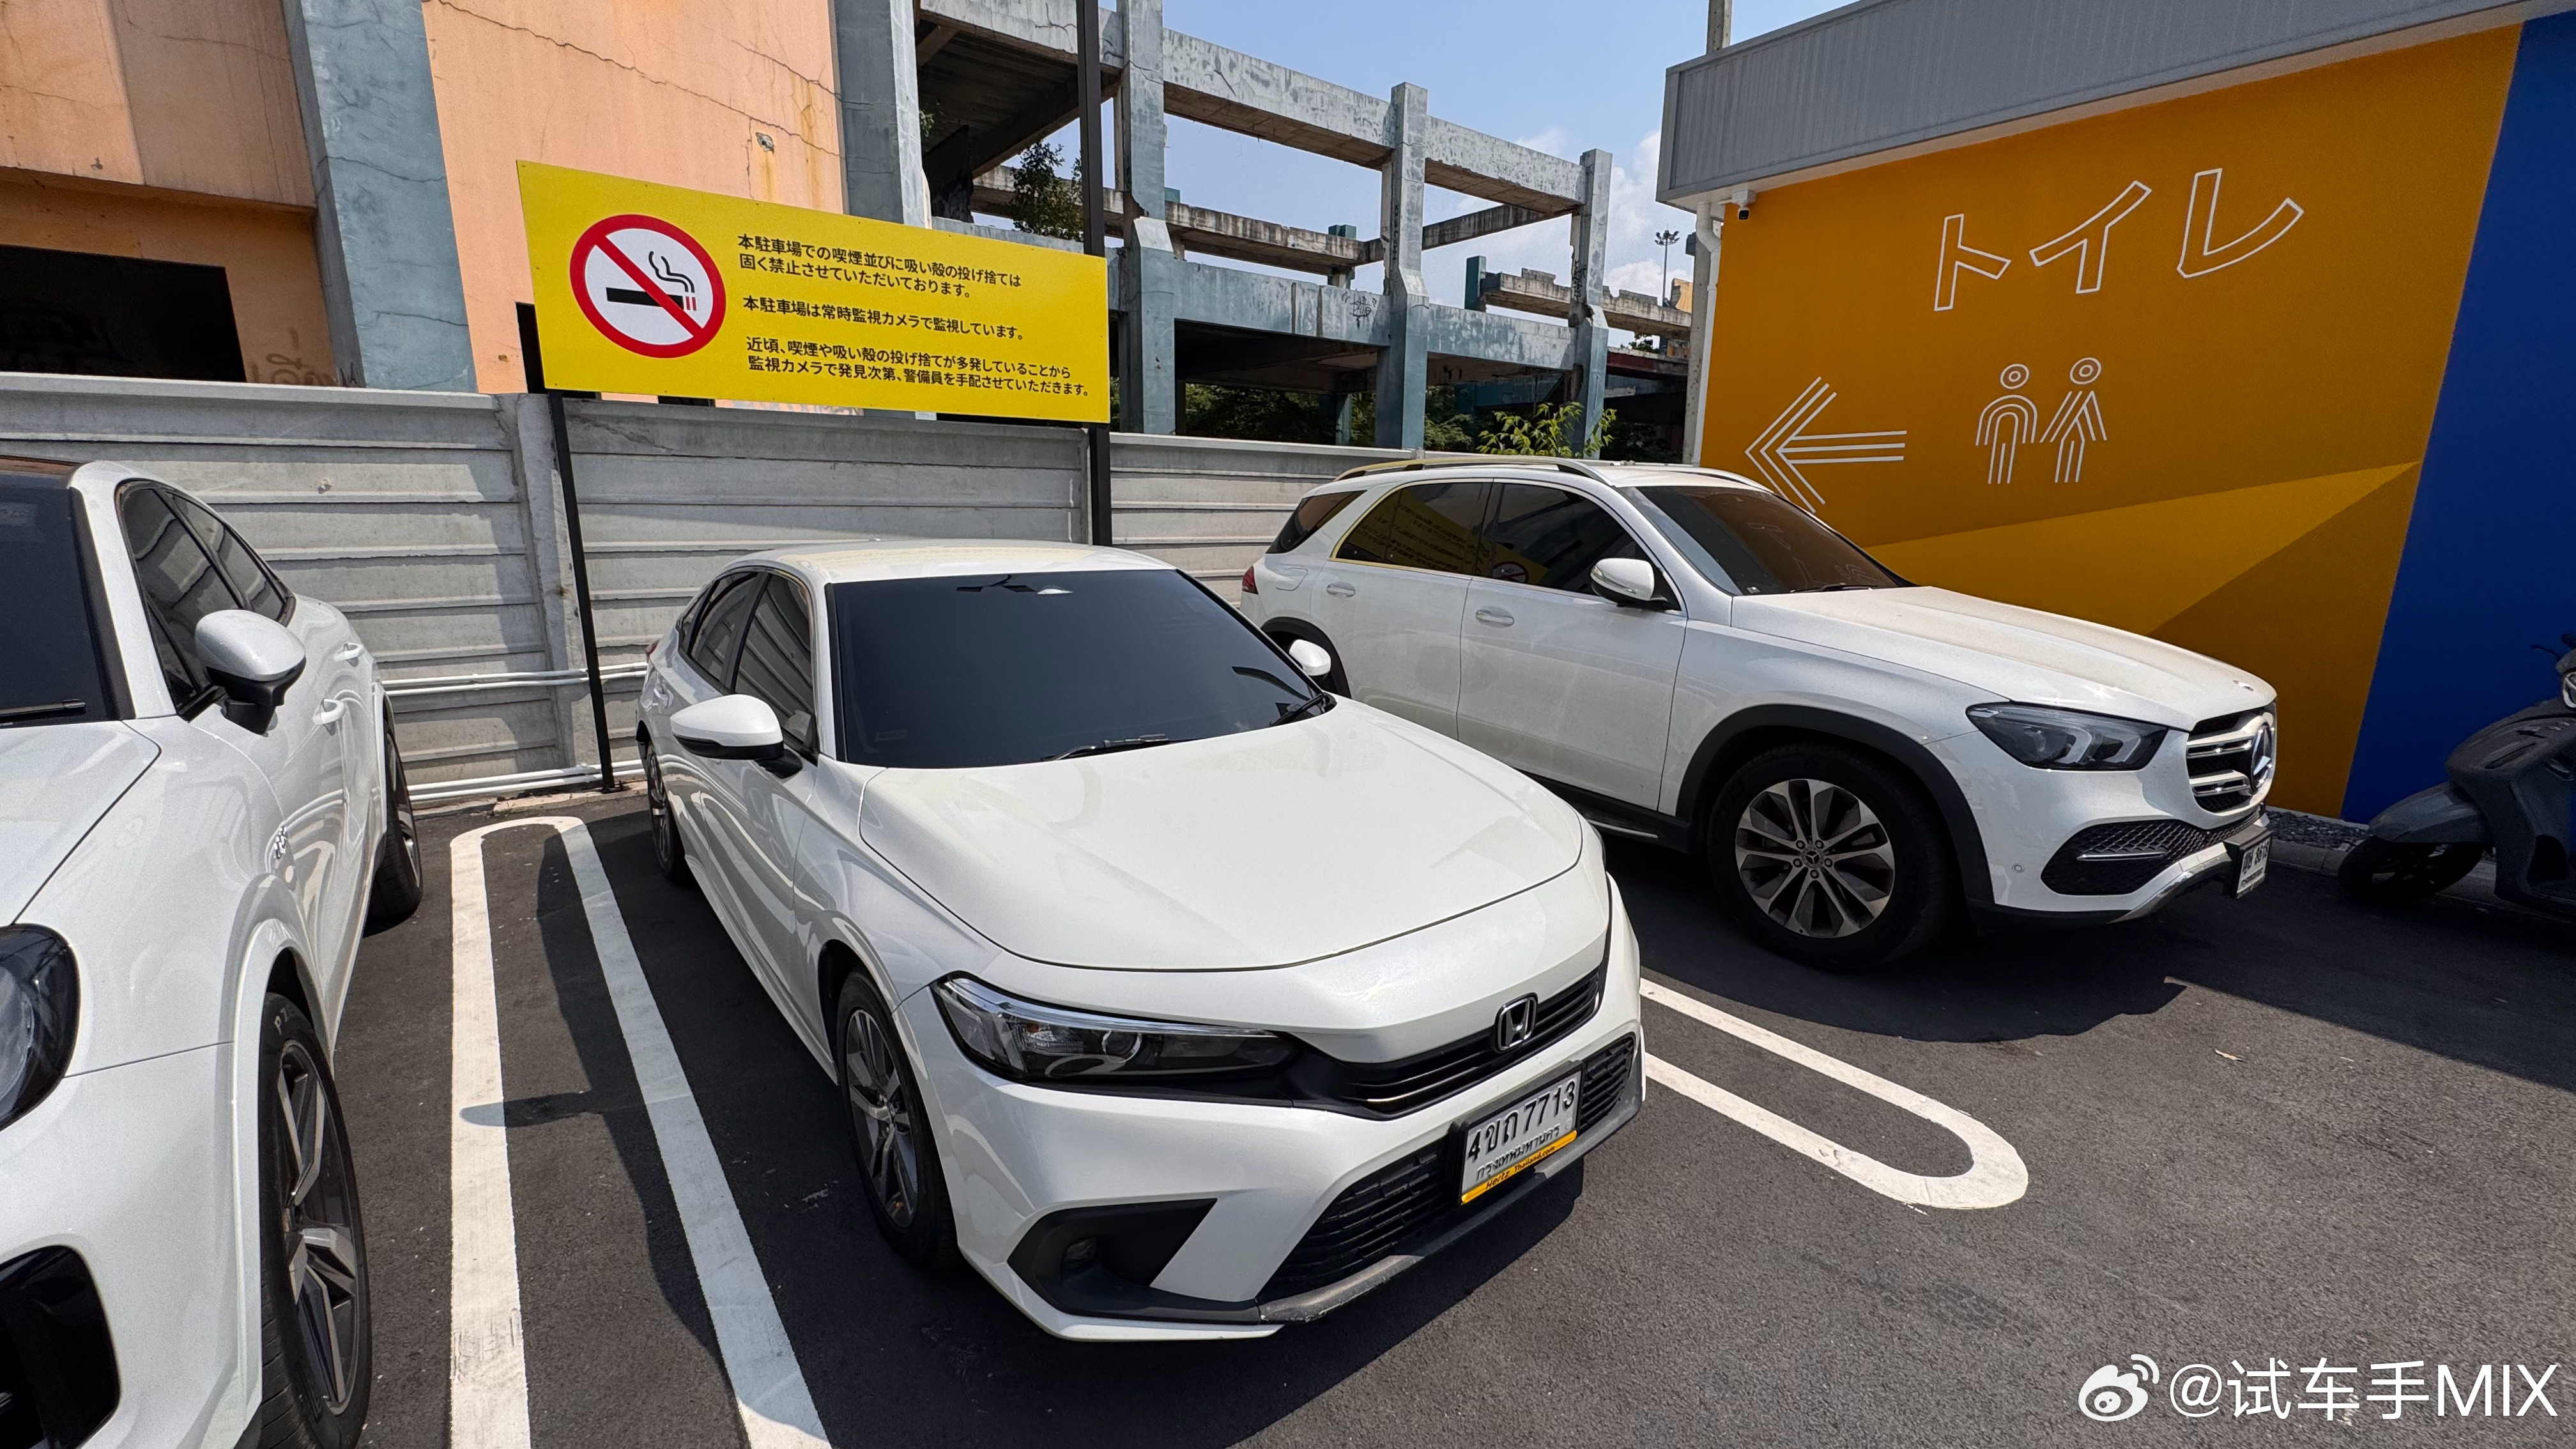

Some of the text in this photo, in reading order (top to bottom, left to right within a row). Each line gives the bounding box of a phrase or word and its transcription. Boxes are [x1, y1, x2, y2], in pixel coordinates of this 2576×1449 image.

[737, 233, 1022, 288] 本駐車場での喫煙並びに吸い殻の投げ捨ては
[1934, 168, 2304, 311] トイレ
[740, 253, 970, 298] 固く禁止させていただいております。
[743, 295, 1023, 340] 本駐車場は常時監視カメラで監視しています。
[747, 337, 1071, 379] 近頃、喫煙や吸い殻の投げ捨てが多発していることから
[749, 356, 1089, 397] 監視カメラで発見次第、警備員を手配させていただきます。
[1523, 1080, 1575, 1134] 7713
[1485, 1170, 1510, 1189] Hertz
